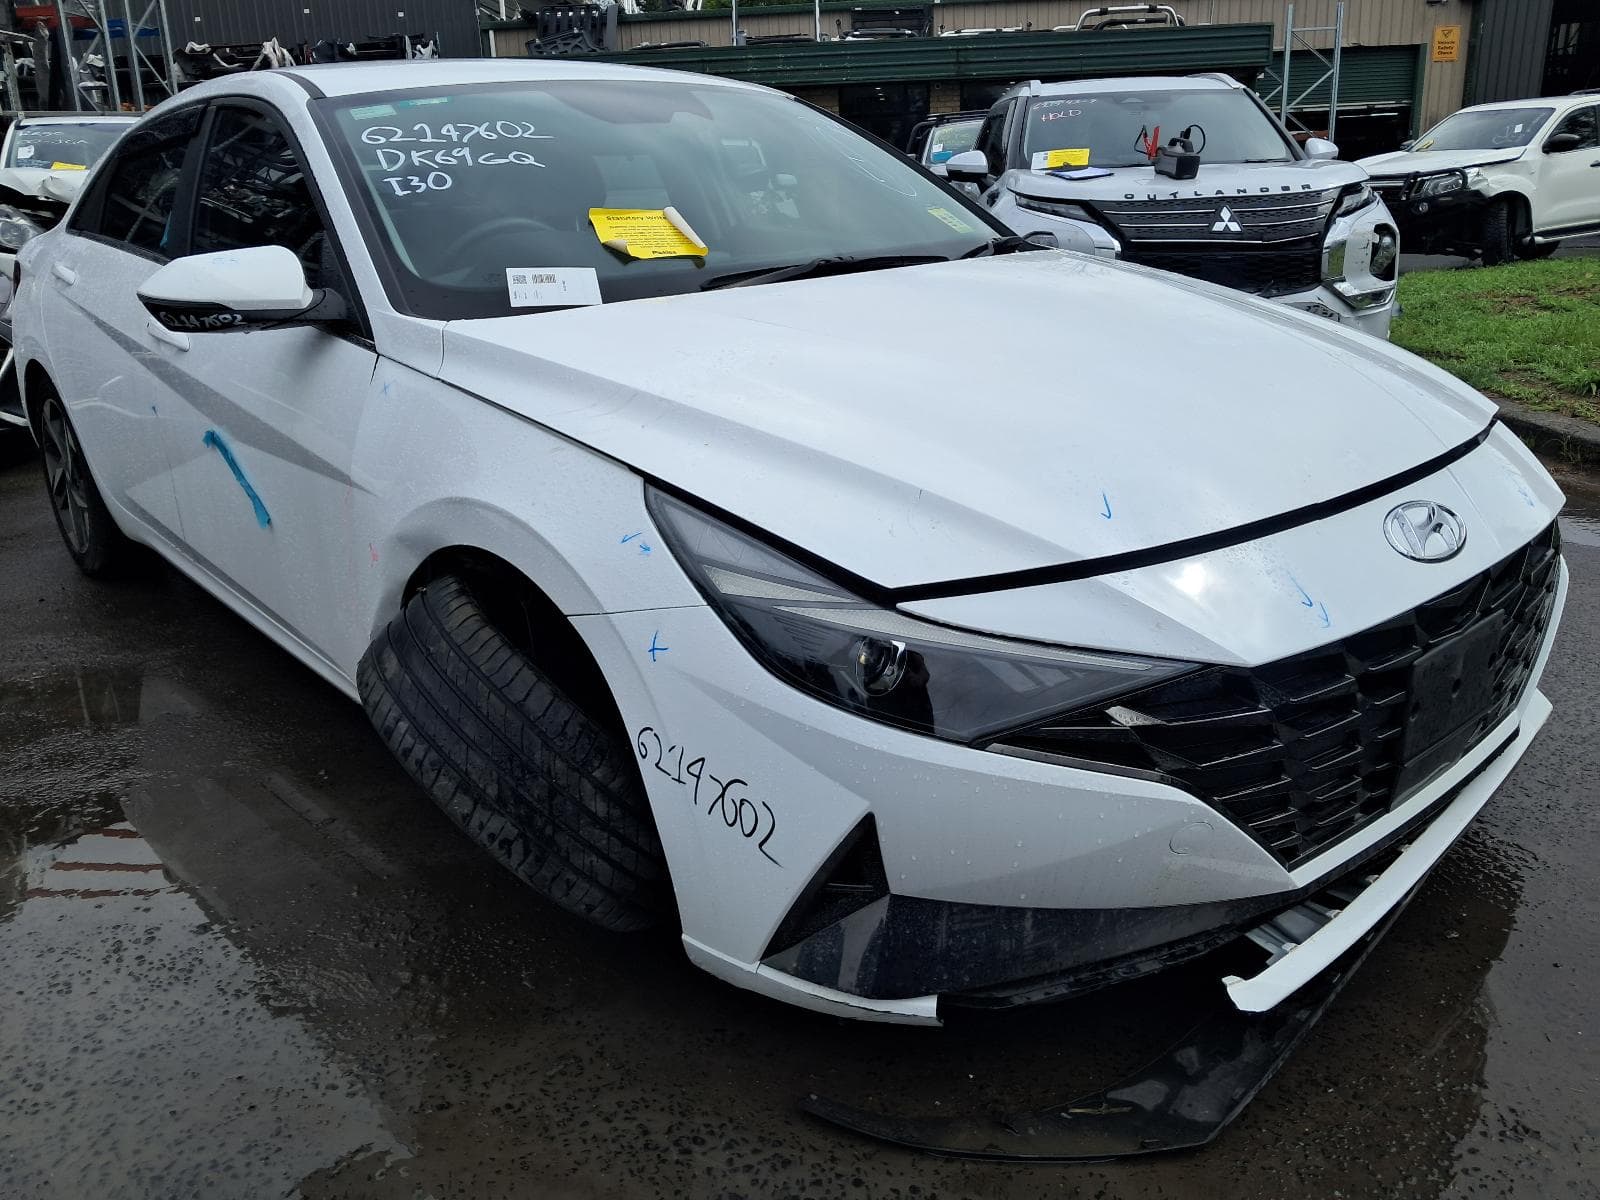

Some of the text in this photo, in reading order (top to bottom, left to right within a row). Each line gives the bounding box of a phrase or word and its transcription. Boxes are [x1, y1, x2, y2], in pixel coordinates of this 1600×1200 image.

[361, 120, 556, 145] 62147602
[382, 171, 452, 196] I30
[1123, 183, 1313, 201] OUTLANDER
